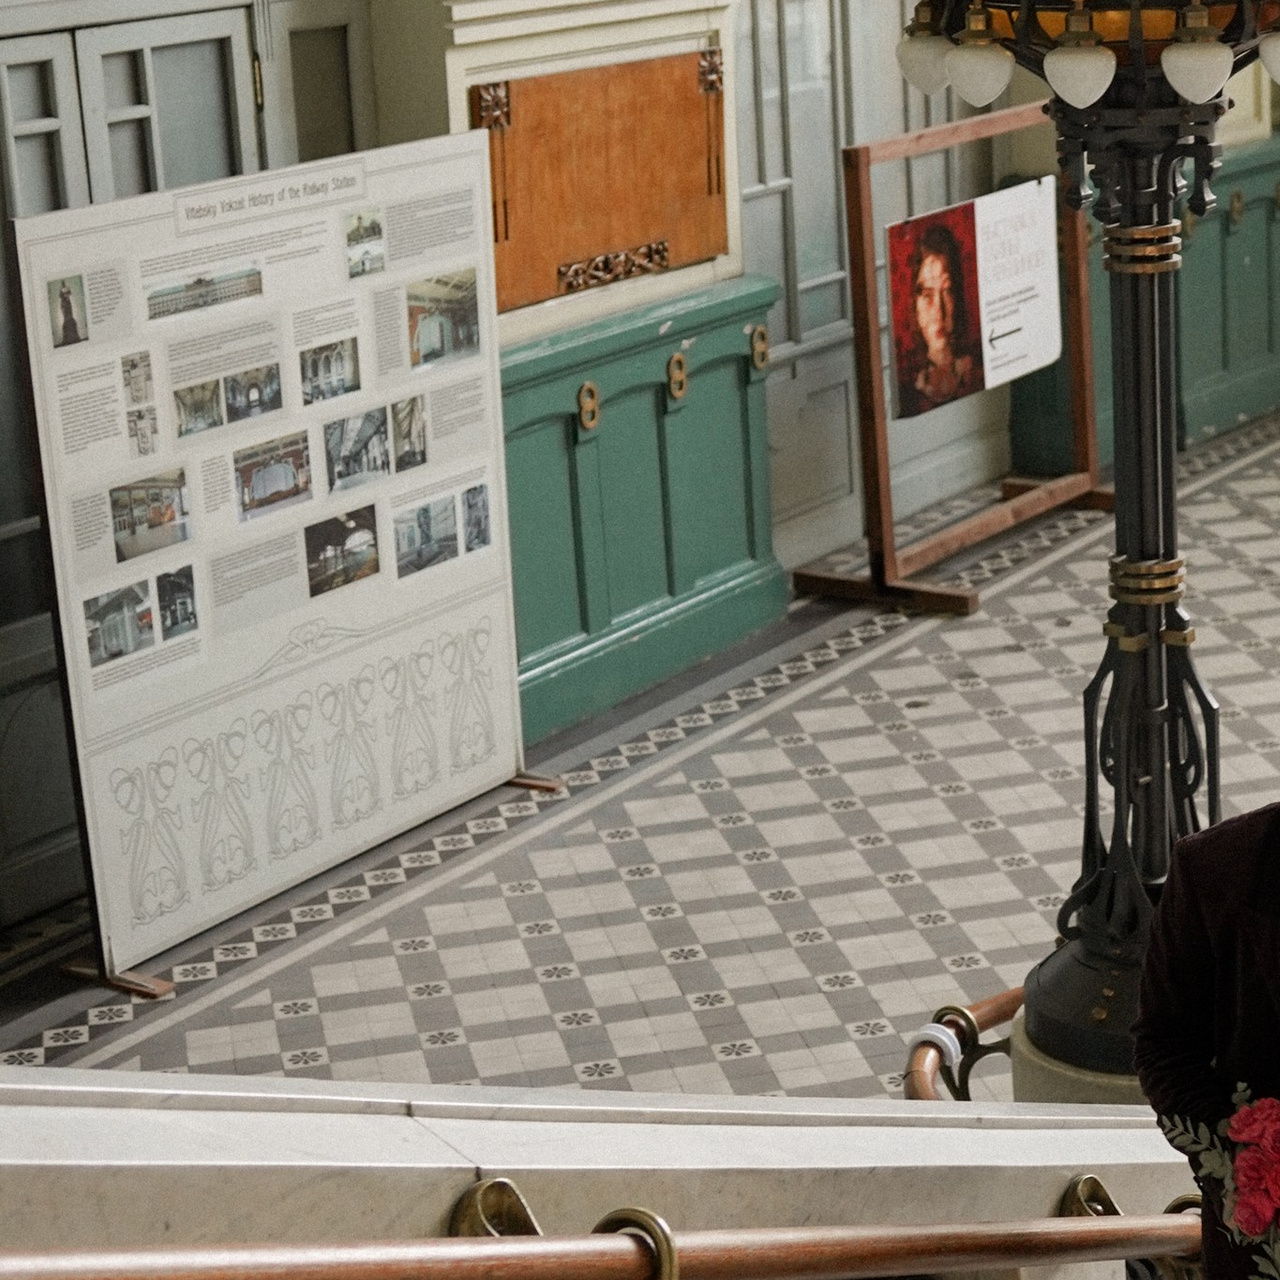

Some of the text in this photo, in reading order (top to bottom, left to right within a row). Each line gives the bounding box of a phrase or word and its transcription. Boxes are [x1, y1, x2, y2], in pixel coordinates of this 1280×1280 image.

[248, 192, 274, 208] History
[277, 187, 285, 202] of
[288, 185, 300, 200] the
[302, 181, 329, 197] Railway
[332, 175, 356, 191] Station
